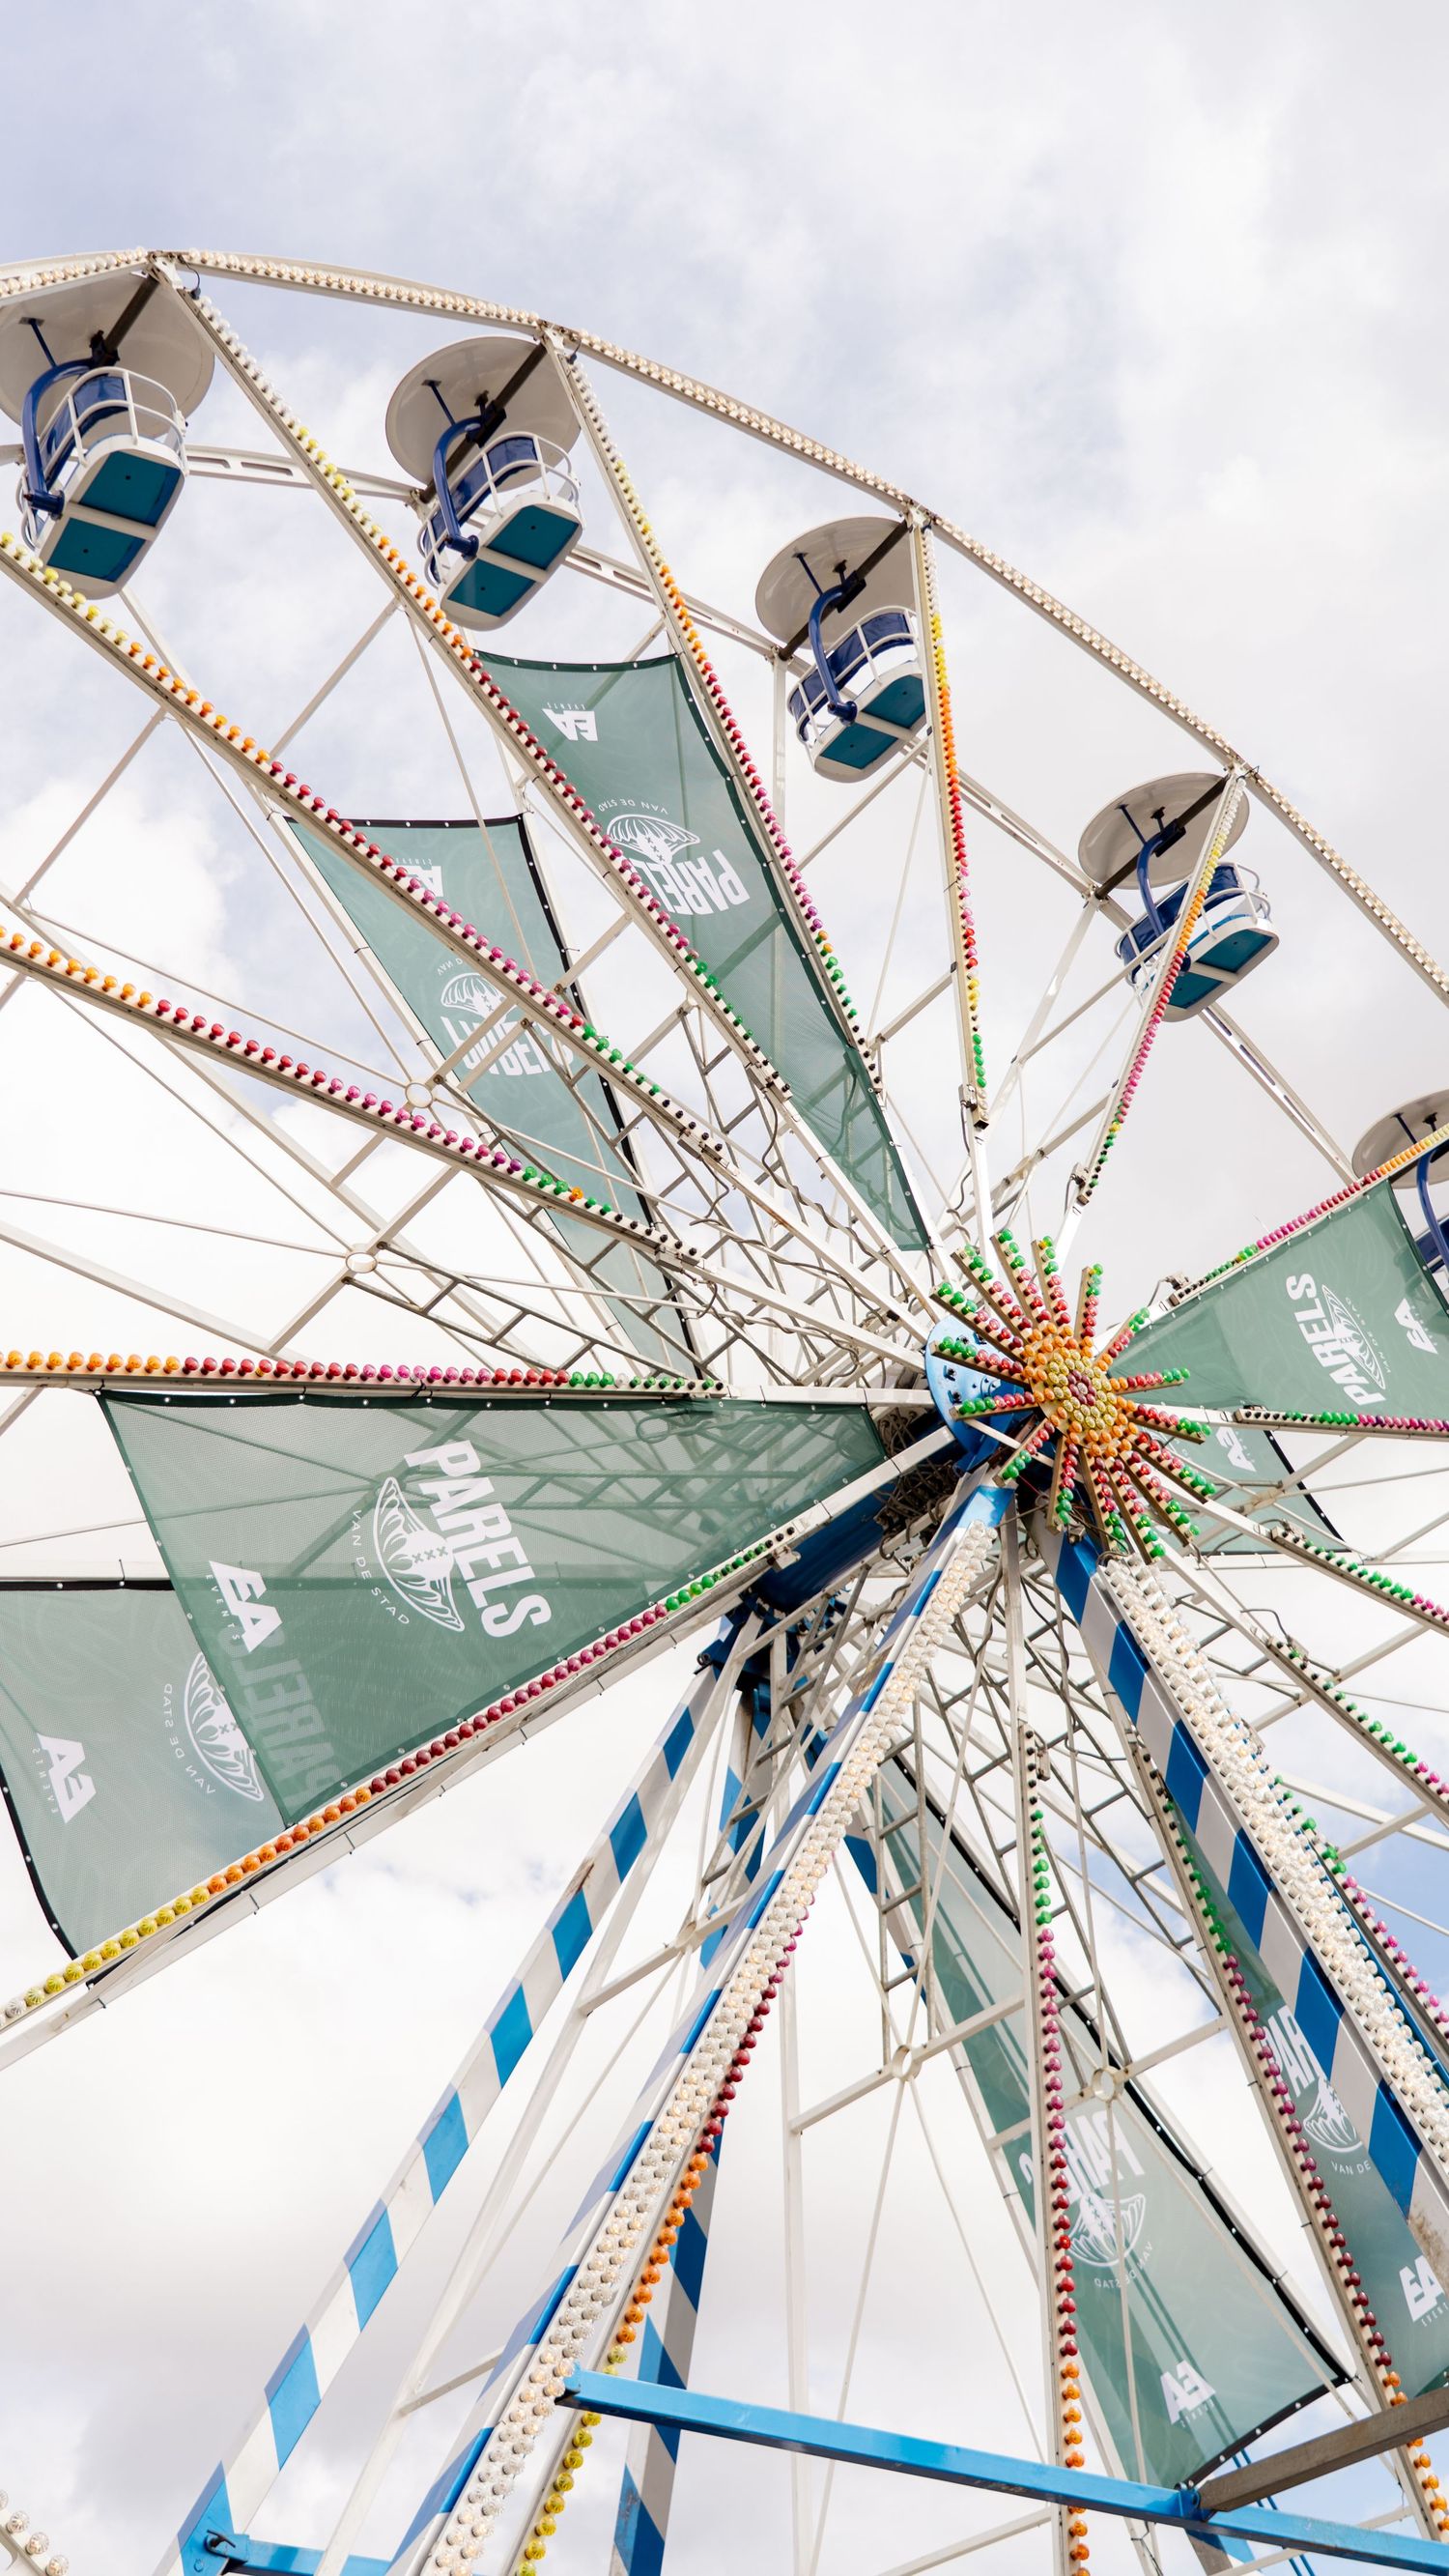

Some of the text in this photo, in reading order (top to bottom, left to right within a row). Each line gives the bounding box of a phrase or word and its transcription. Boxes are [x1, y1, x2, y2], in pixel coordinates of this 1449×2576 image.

[542, 708, 598, 741] EA
[598, 798, 669, 816] VAN DE STAD
[627, 849, 751, 916] PAREL
[1286, 1273, 1386, 1406] PARELS
[352, 1509, 411, 1625] VAN DE STAD
[403, 1439, 553, 1638] PARELS
[205, 1573, 242, 1641] EVENTS
[209, 1560, 283, 1653] EA
[1330, 2160, 1372, 2175] VAN DE
